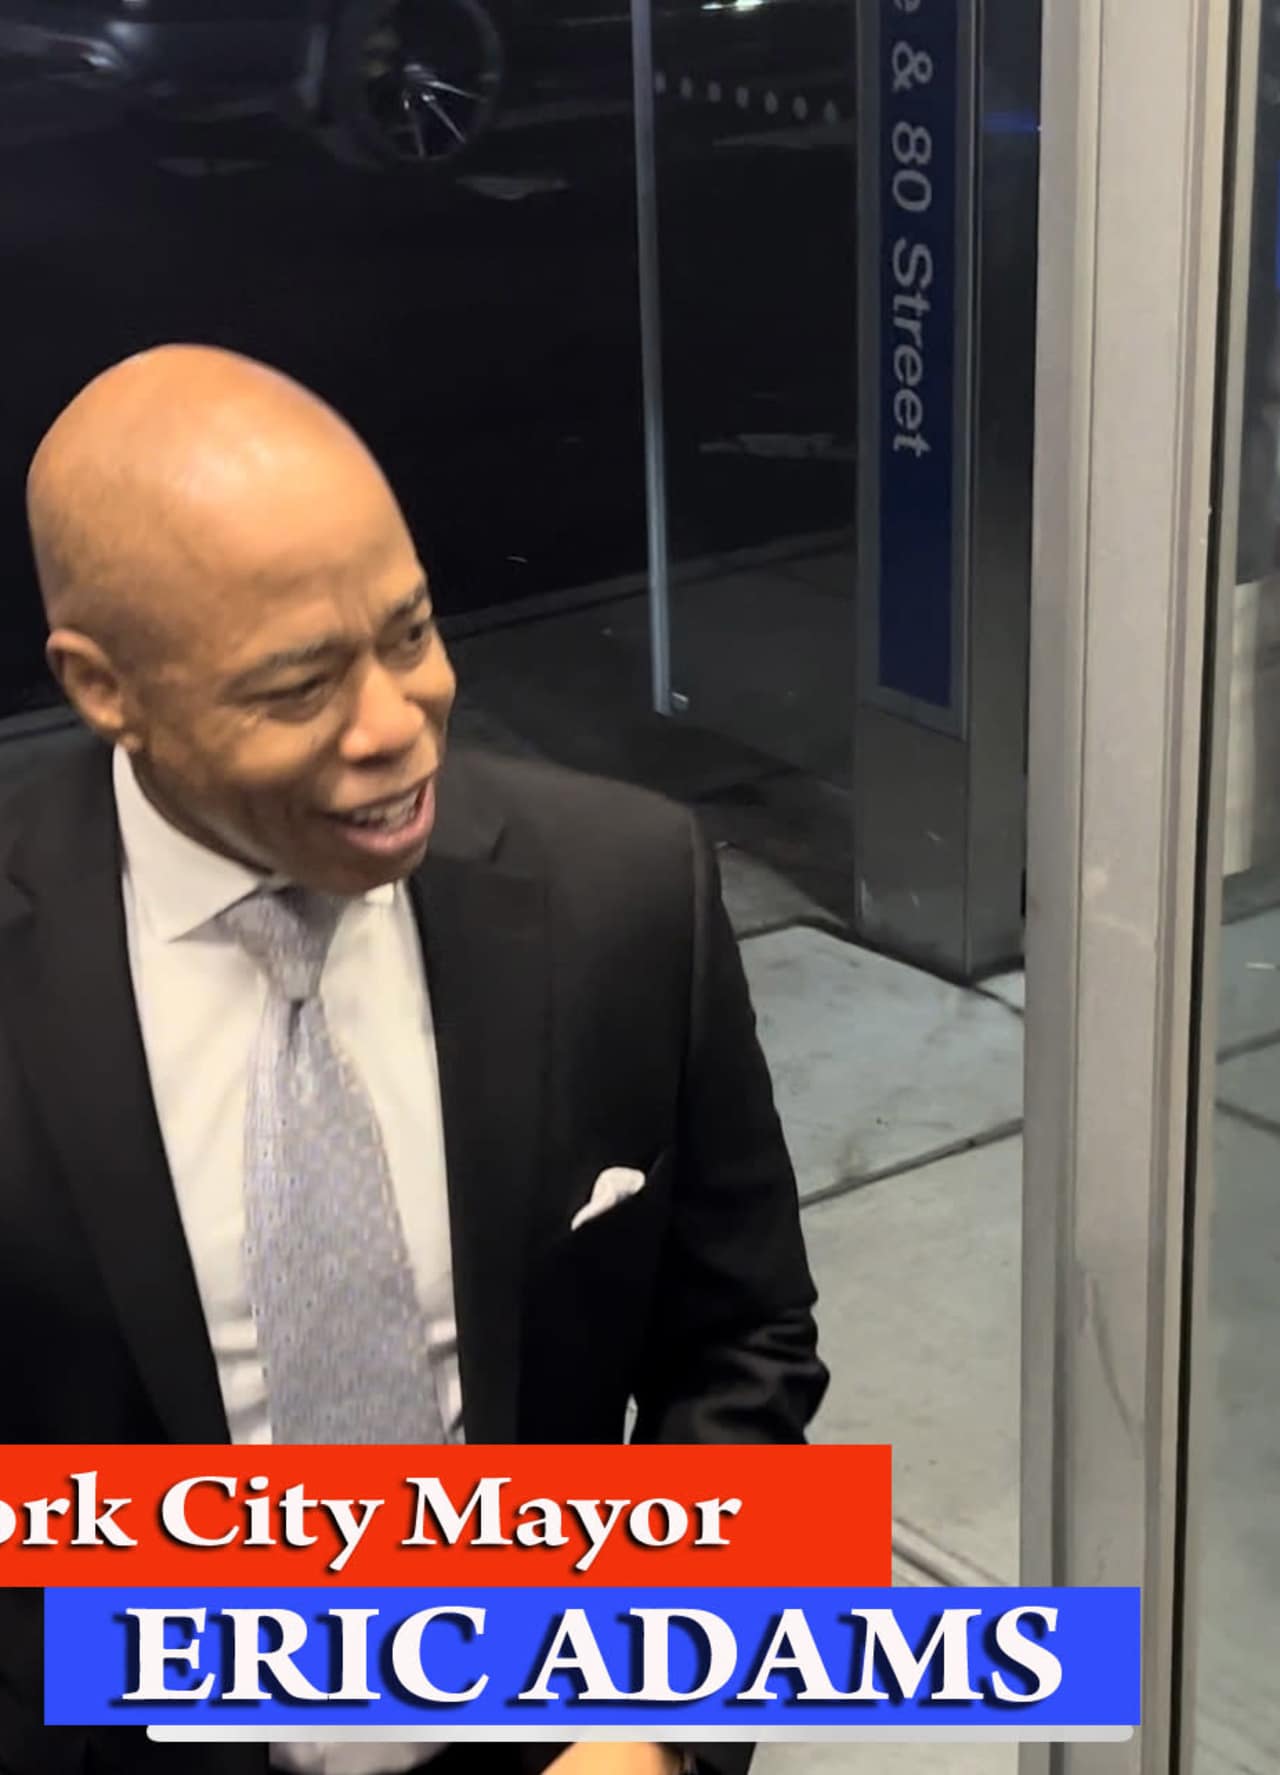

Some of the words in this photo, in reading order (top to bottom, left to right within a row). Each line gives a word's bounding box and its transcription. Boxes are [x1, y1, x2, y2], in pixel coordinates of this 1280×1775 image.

[892, 40, 933, 93] &
[892, 120, 932, 213] 80
[892, 236, 933, 458] Street
